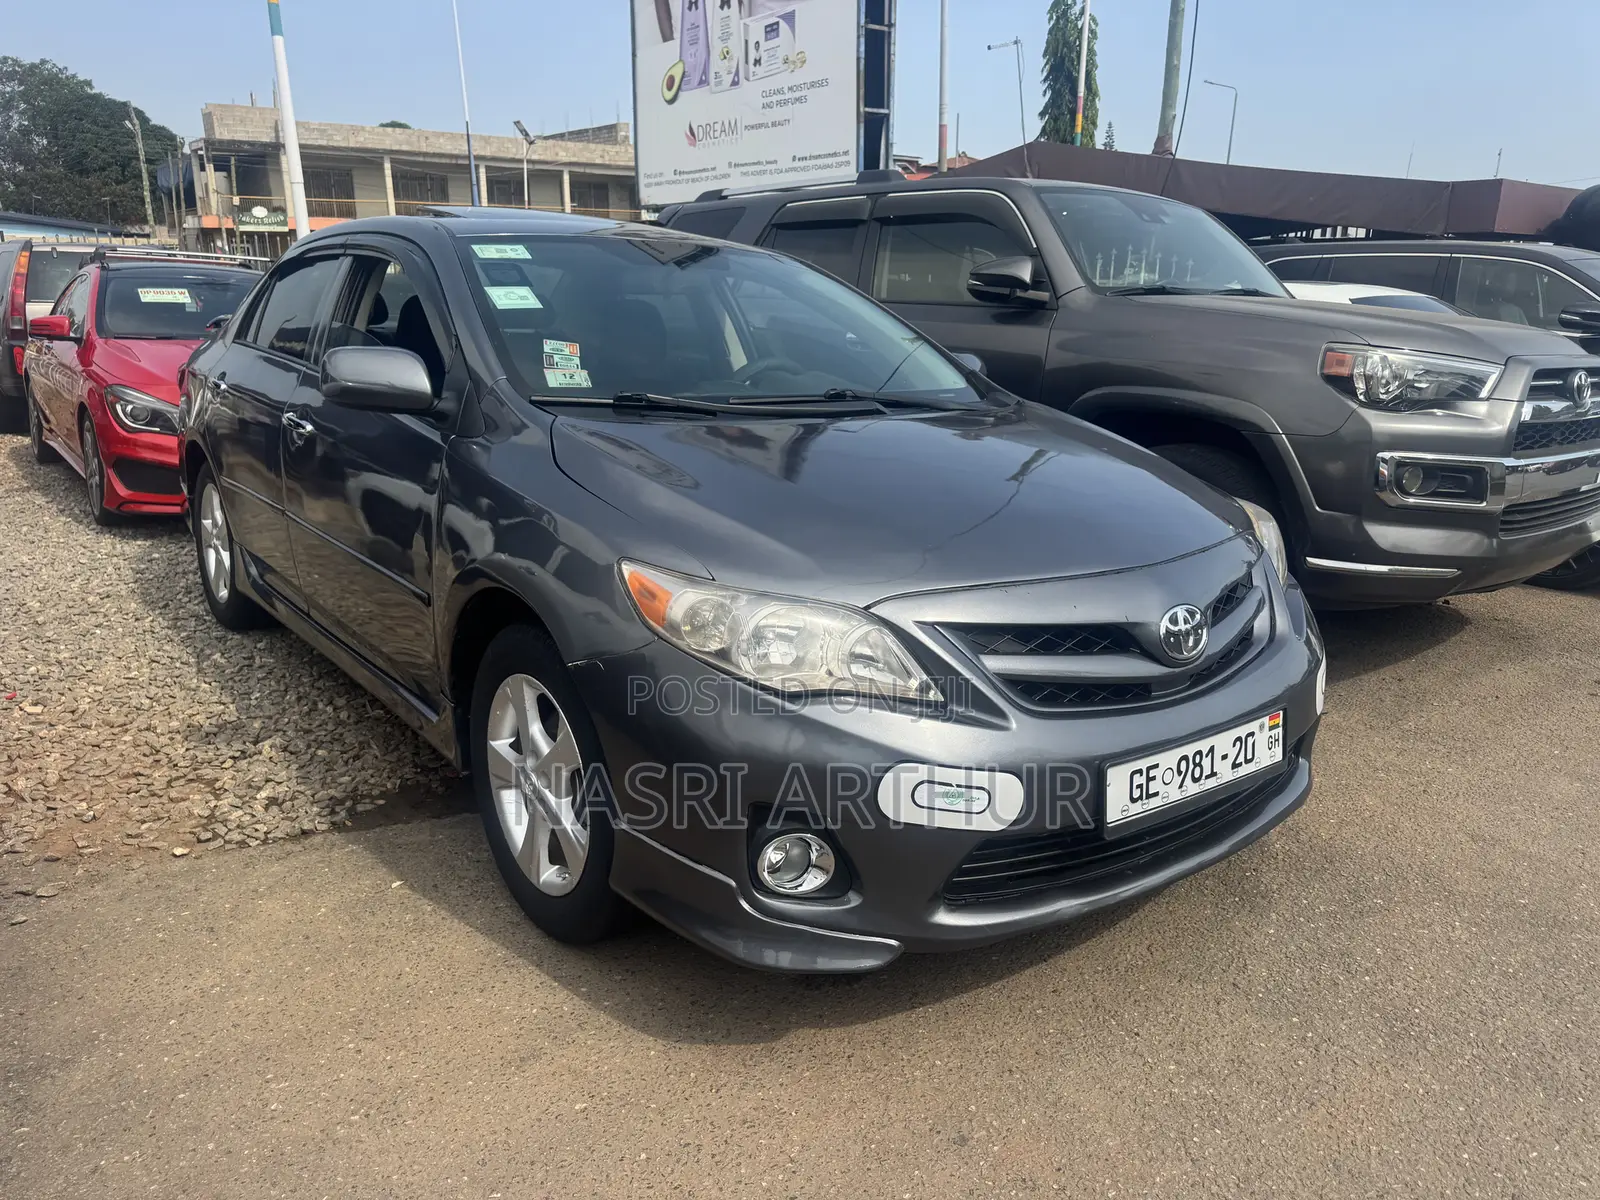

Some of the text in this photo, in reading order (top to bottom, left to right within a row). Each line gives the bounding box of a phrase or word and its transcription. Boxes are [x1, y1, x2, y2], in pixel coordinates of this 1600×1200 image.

[761, 78, 829, 98] CLEANS, MOISTURISES
[762, 95, 808, 110] AND PERFUMES
[697, 117, 738, 142] DREAM
[744, 119, 791, 132] POWERFUL BEAUTY
[1267, 732, 1280, 751] GH
[1129, 762, 1160, 804] GE
